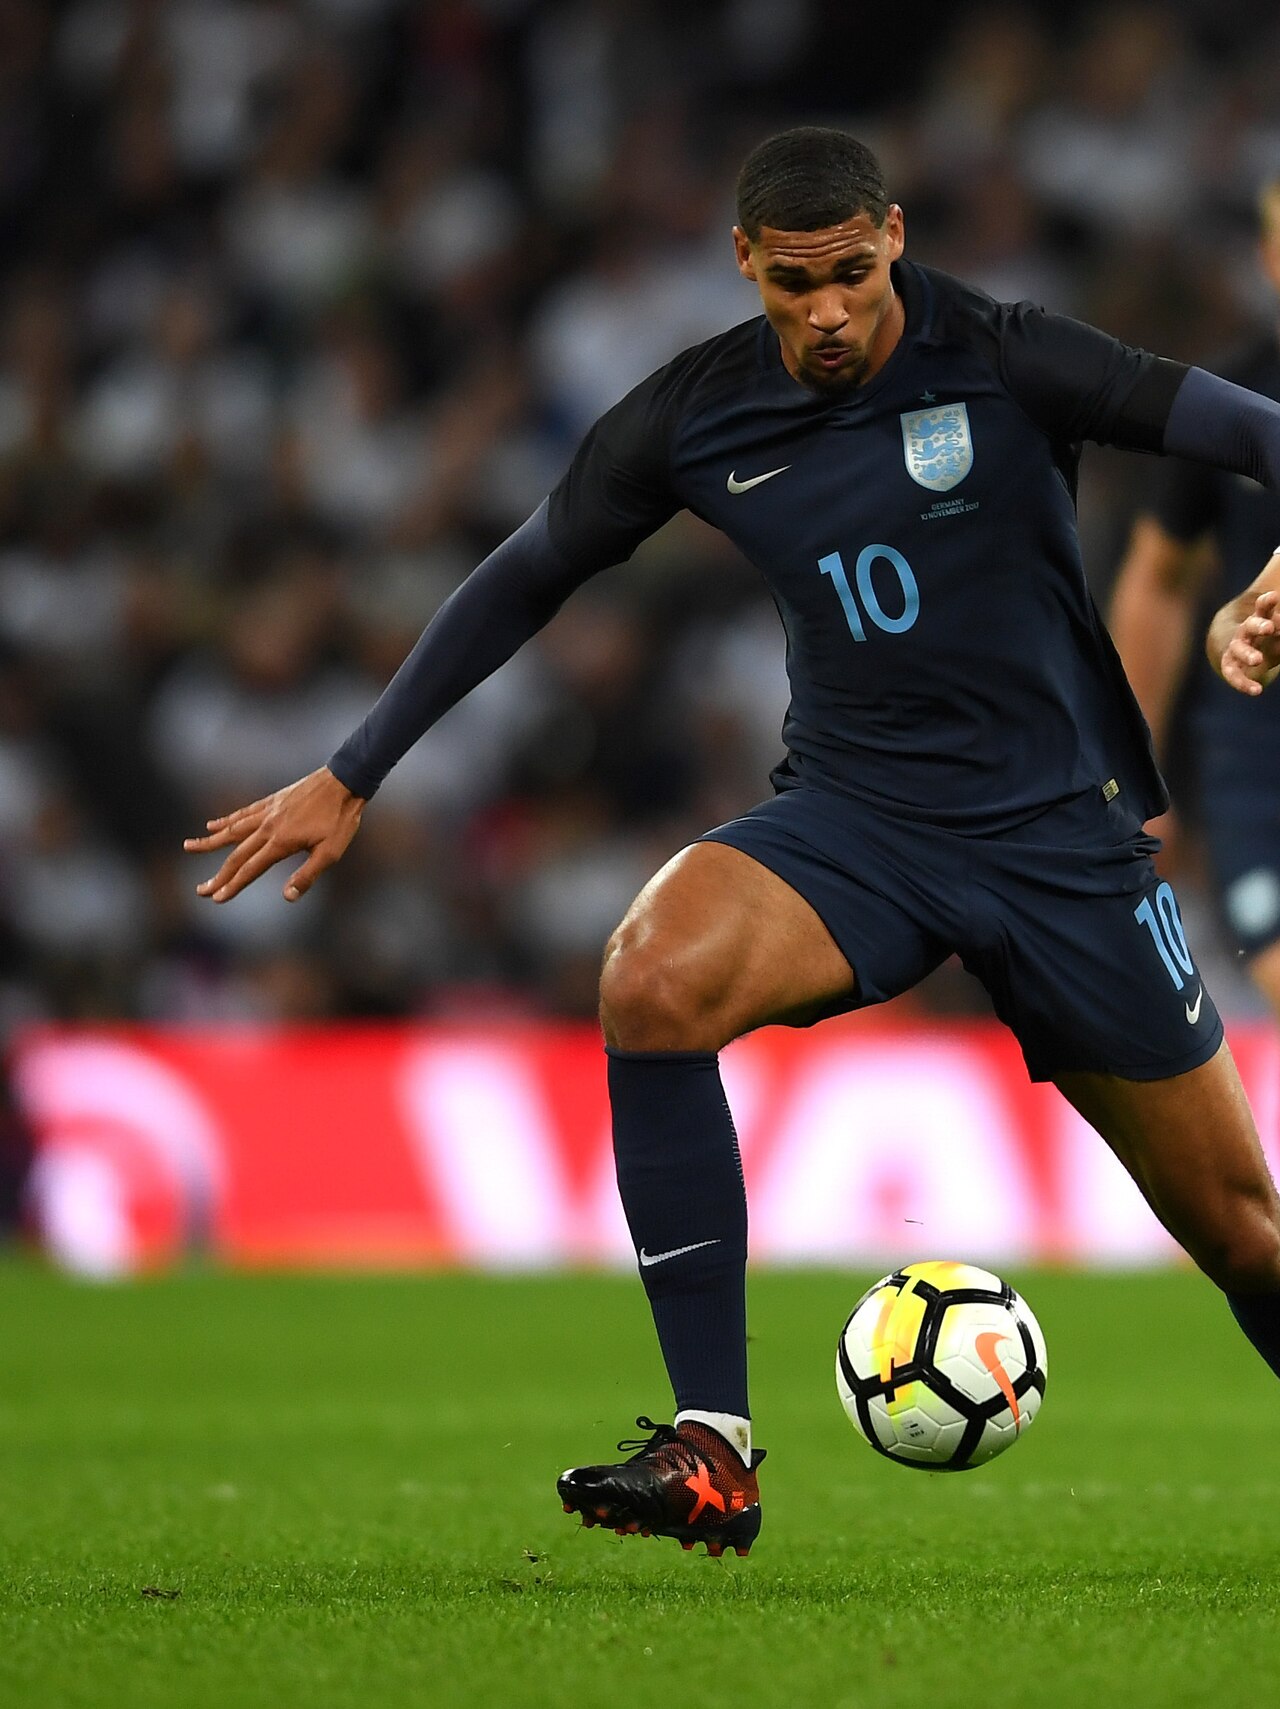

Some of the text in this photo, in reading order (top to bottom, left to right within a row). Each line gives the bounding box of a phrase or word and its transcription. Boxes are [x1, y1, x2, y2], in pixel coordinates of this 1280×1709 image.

[928, 505, 965, 520] NOVEMBER
[931, 498, 965, 511] GERMANY
[817, 543, 920, 642] 10
[1133, 881, 1194, 991] 10
